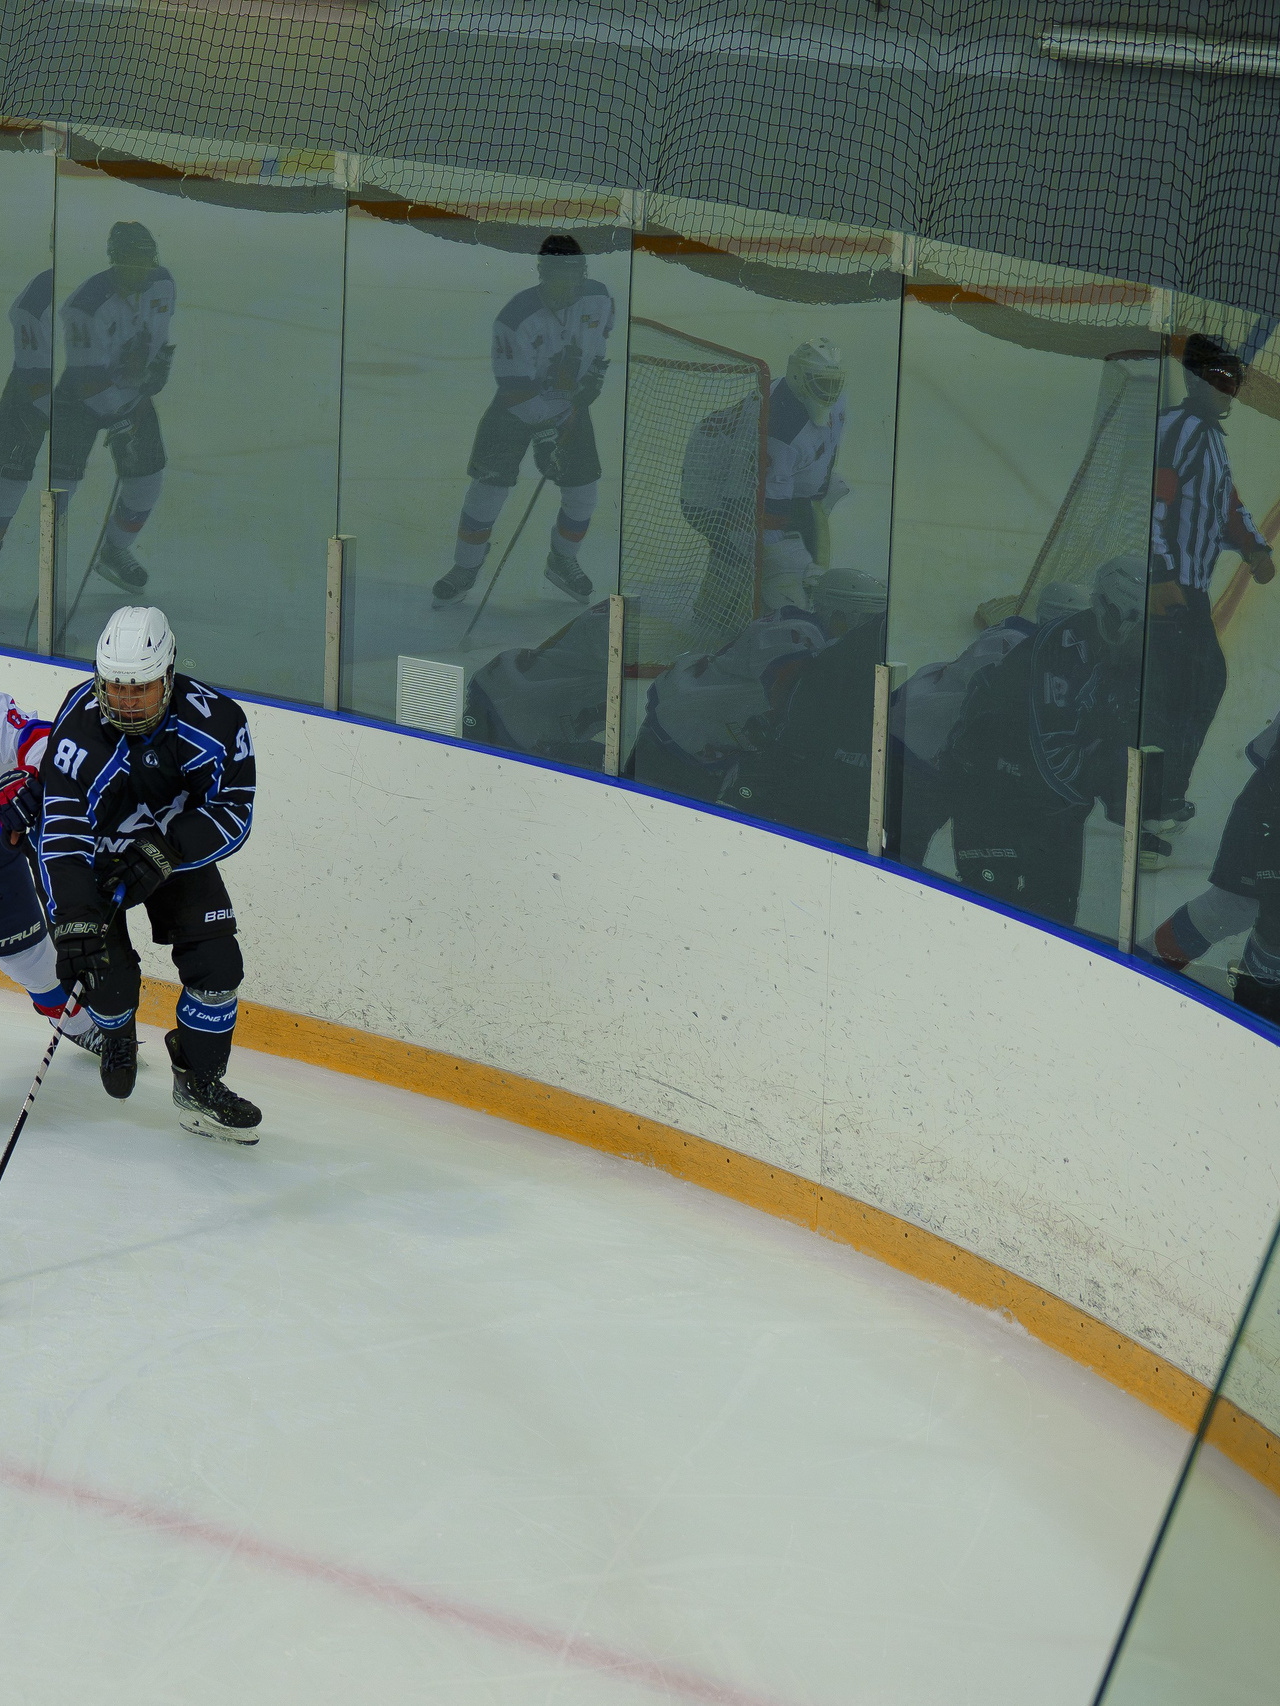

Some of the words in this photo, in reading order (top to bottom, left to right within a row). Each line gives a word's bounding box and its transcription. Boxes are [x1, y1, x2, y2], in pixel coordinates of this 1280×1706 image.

[53, 737, 89, 780] 81
[196, 1011, 221, 1022] ONE
[222, 1005, 237, 1022] TIM
